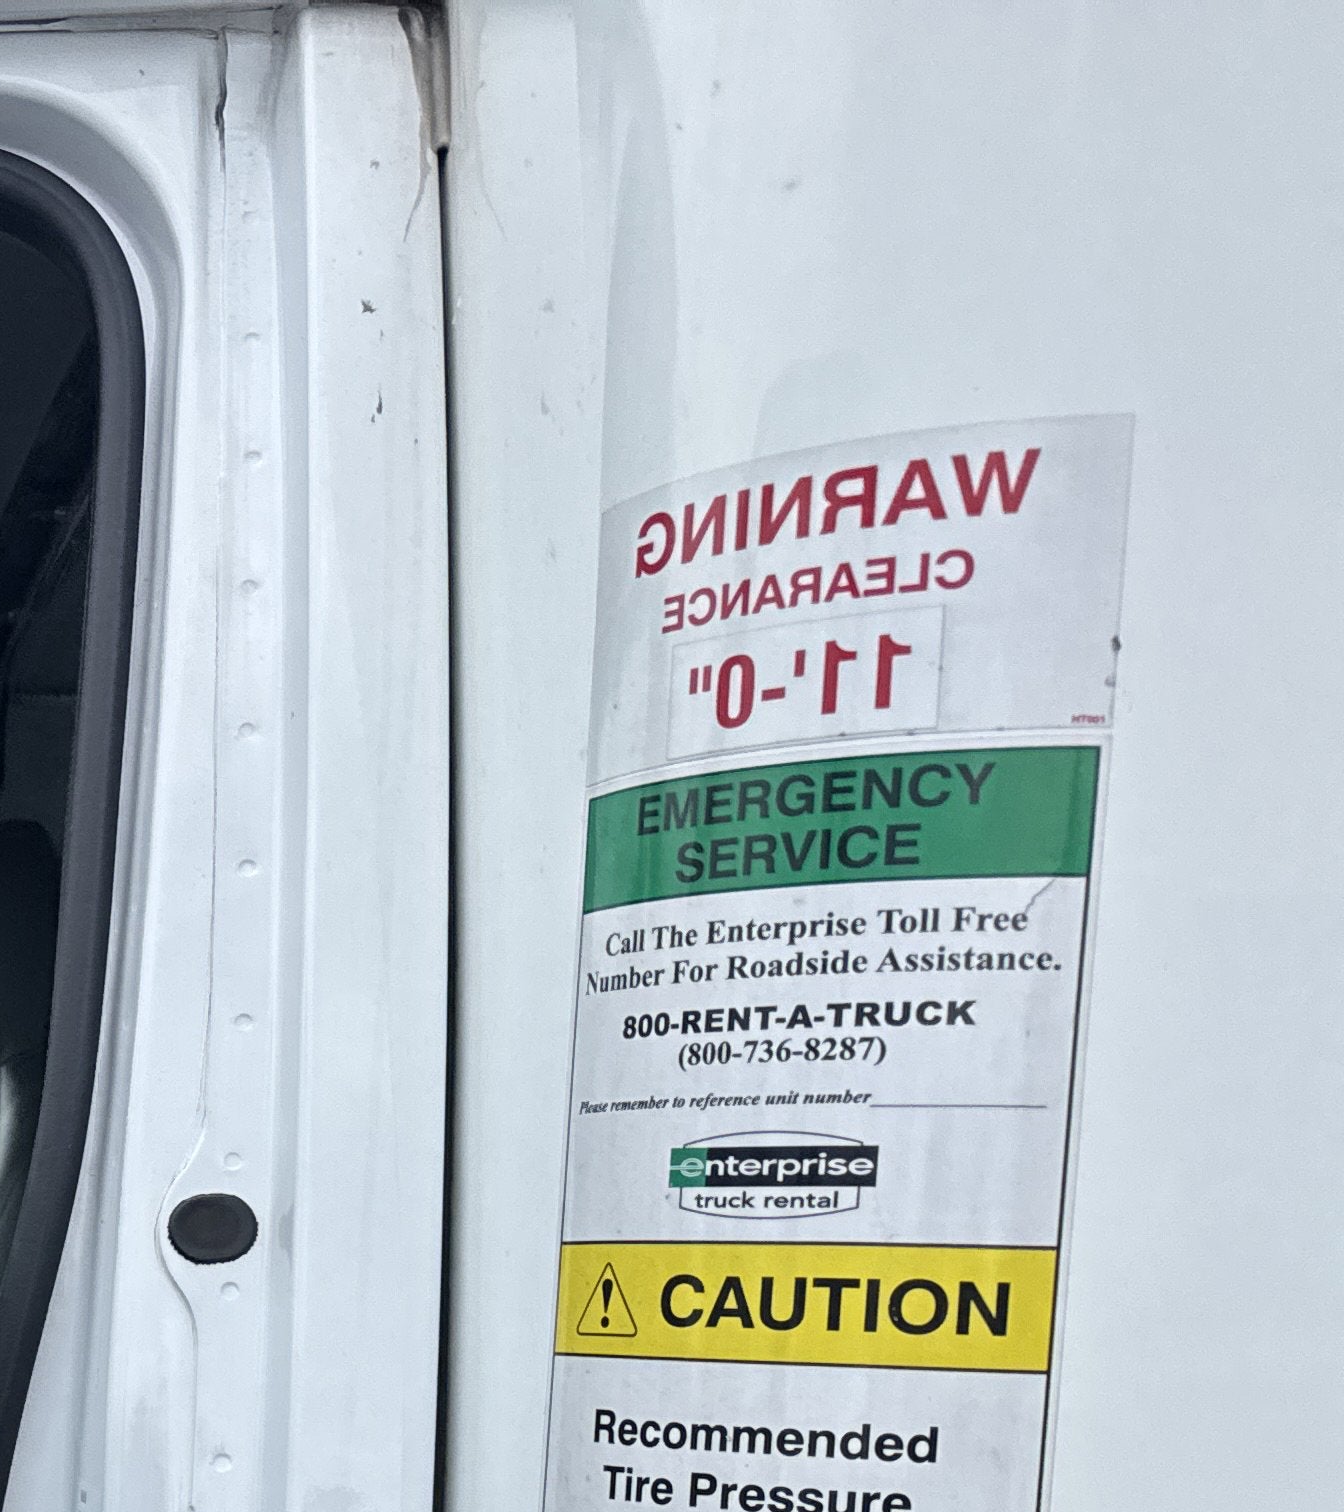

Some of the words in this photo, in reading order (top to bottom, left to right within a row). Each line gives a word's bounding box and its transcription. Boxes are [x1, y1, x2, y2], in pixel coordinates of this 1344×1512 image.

[637, 761, 996, 836] EMERGENCY
[675, 823, 922, 884] SERVICE
[605, 929, 645, 957] Call
[652, 925, 698, 950] The
[707, 912, 866, 946] Enterprise
[878, 908, 939, 935] Toll
[953, 907, 1028, 933] Free
[585, 966, 665, 996] Number
[671, 961, 719, 984] For
[728, 951, 867, 980] Roadside
[876, 949, 1062, 973] Assistance.
[623, 1000, 976, 1039] 800-RENT-A-TRUCK
[678, 1037, 887, 1071] (800-736-8287)
[579, 1101, 608, 1115] Please
[611, 1096, 669, 1112] remember
[672, 1096, 686, 1108] to
[689, 1094, 760, 1110] reference
[765, 1091, 800, 1105] unit
[802, 1090, 871, 1104] number
[678, 1152, 875, 1182] enterprise
[694, 1192, 755, 1208] truck
[764, 1191, 838, 1208] rental
[660, 1273, 1011, 1337] CAUTION
[594, 1408, 939, 1464] Recommended
[603, 1465, 673, 1506] Tire
